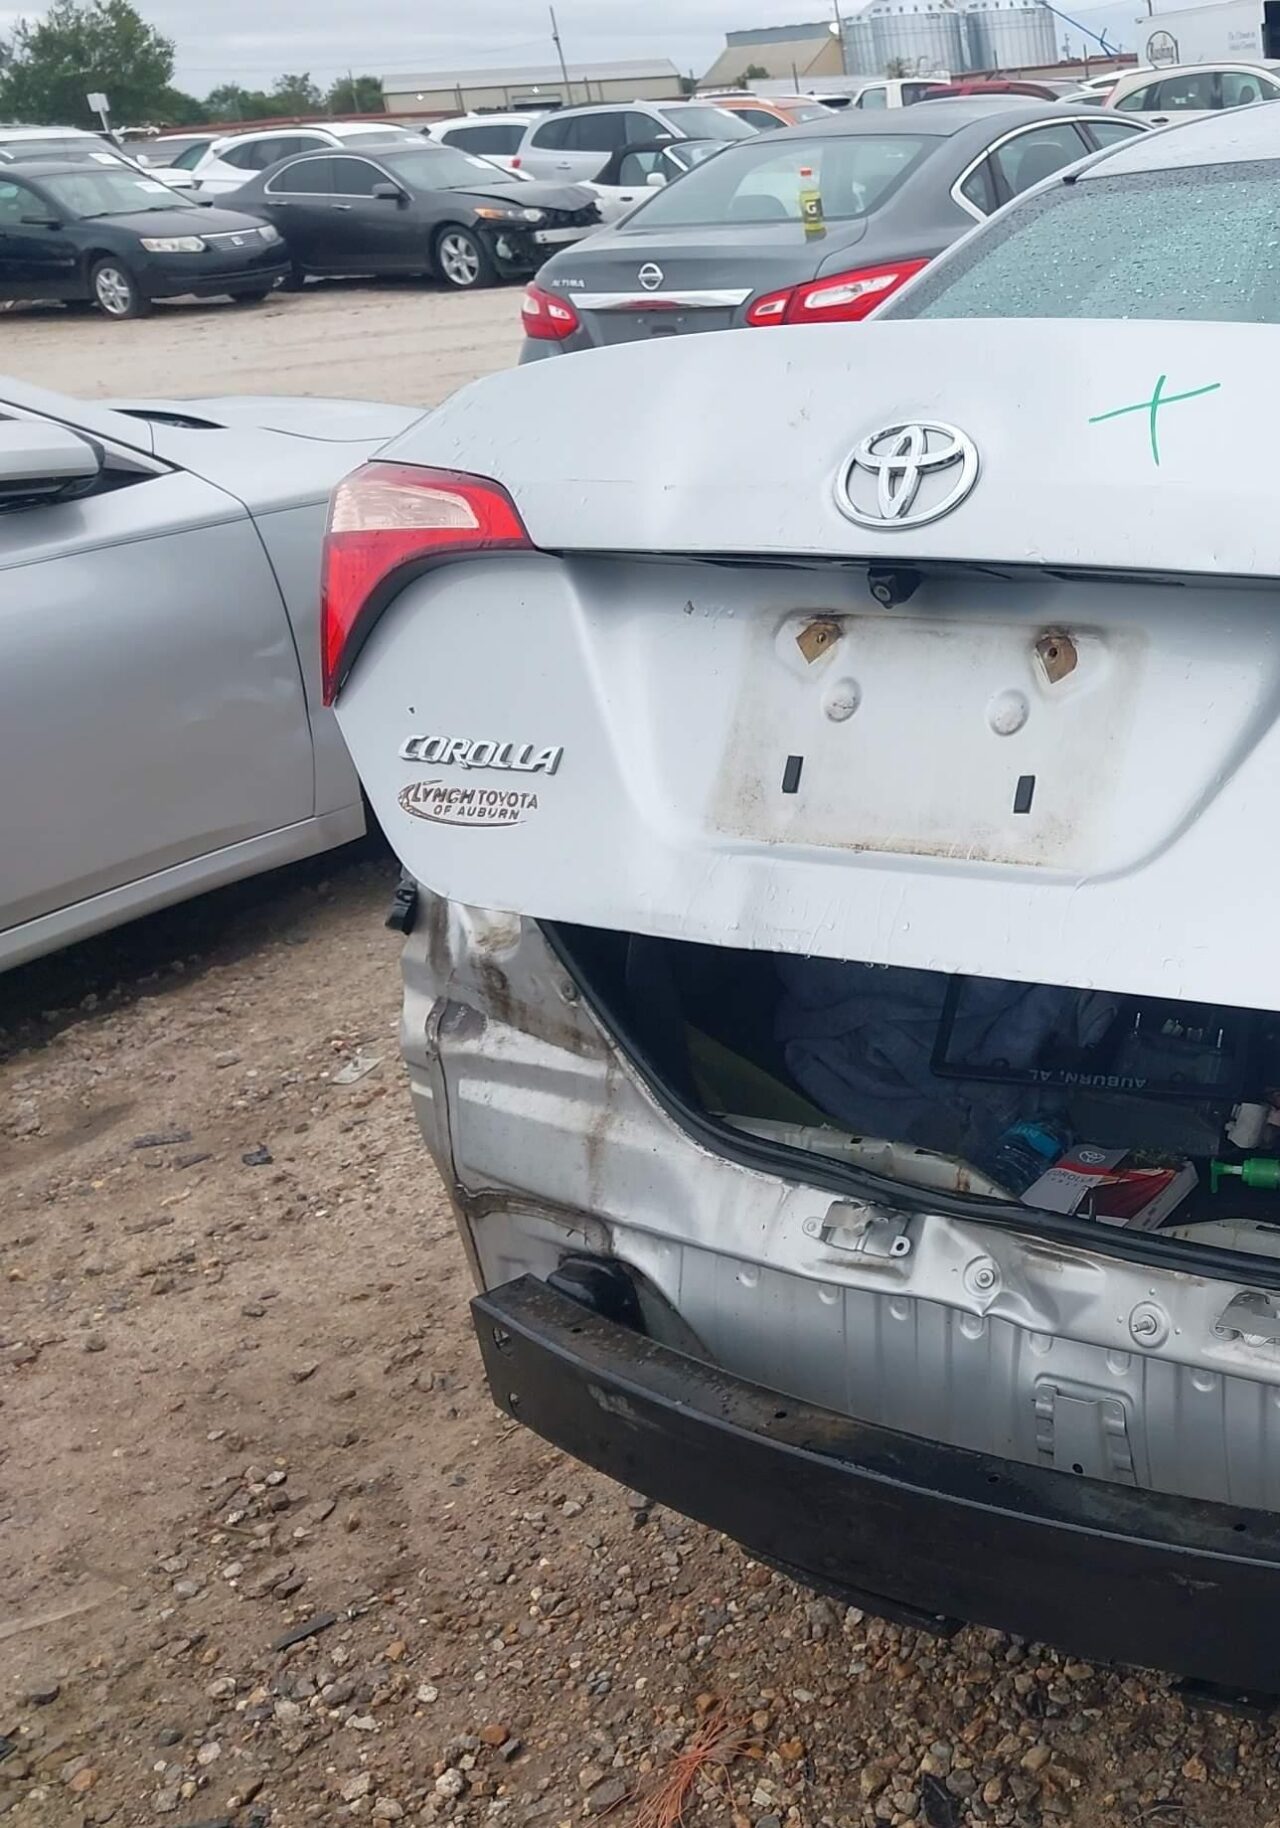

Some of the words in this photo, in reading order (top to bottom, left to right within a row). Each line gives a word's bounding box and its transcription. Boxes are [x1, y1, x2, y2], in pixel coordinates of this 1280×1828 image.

[806, 201, 817, 214] G
[398, 735, 564, 775] COROLLA
[411, 782, 475, 805] LYNCH
[478, 790, 538, 809] TOYOTA
[433, 804, 451, 816] OF
[457, 805, 520, 820] AUBURN
[1028, 1068, 1052, 1081] AL
[1060, 1069, 1147, 1089] AUBURN,
